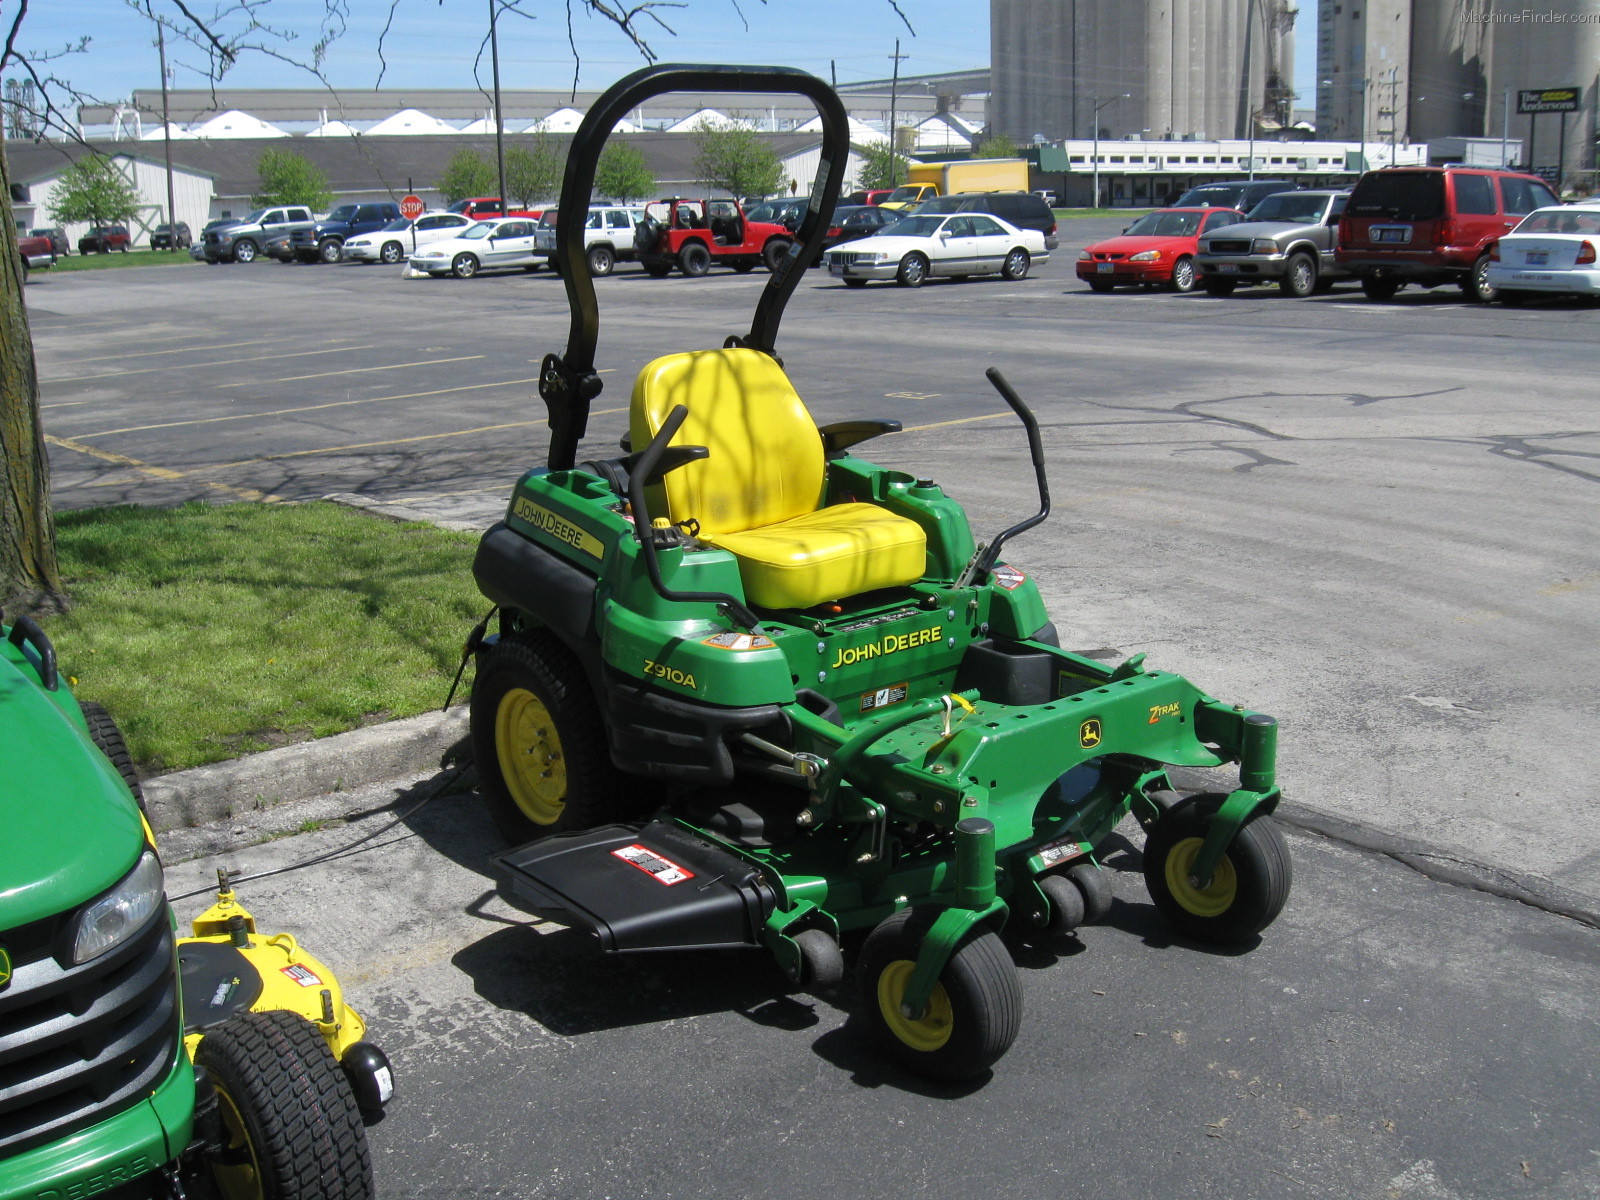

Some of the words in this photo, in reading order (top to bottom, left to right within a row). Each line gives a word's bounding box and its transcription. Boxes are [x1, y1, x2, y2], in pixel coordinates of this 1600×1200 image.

[1519, 101, 1576, 112] Andersons
[1520, 92, 1540, 103] The
[402, 203, 422, 213] STOP
[518, 500, 545, 527] JOHN
[545, 514, 584, 547] DEERE
[832, 641, 882, 669] JOHN
[884, 625, 942, 655] DEERE
[643, 659, 697, 690] Z910A
